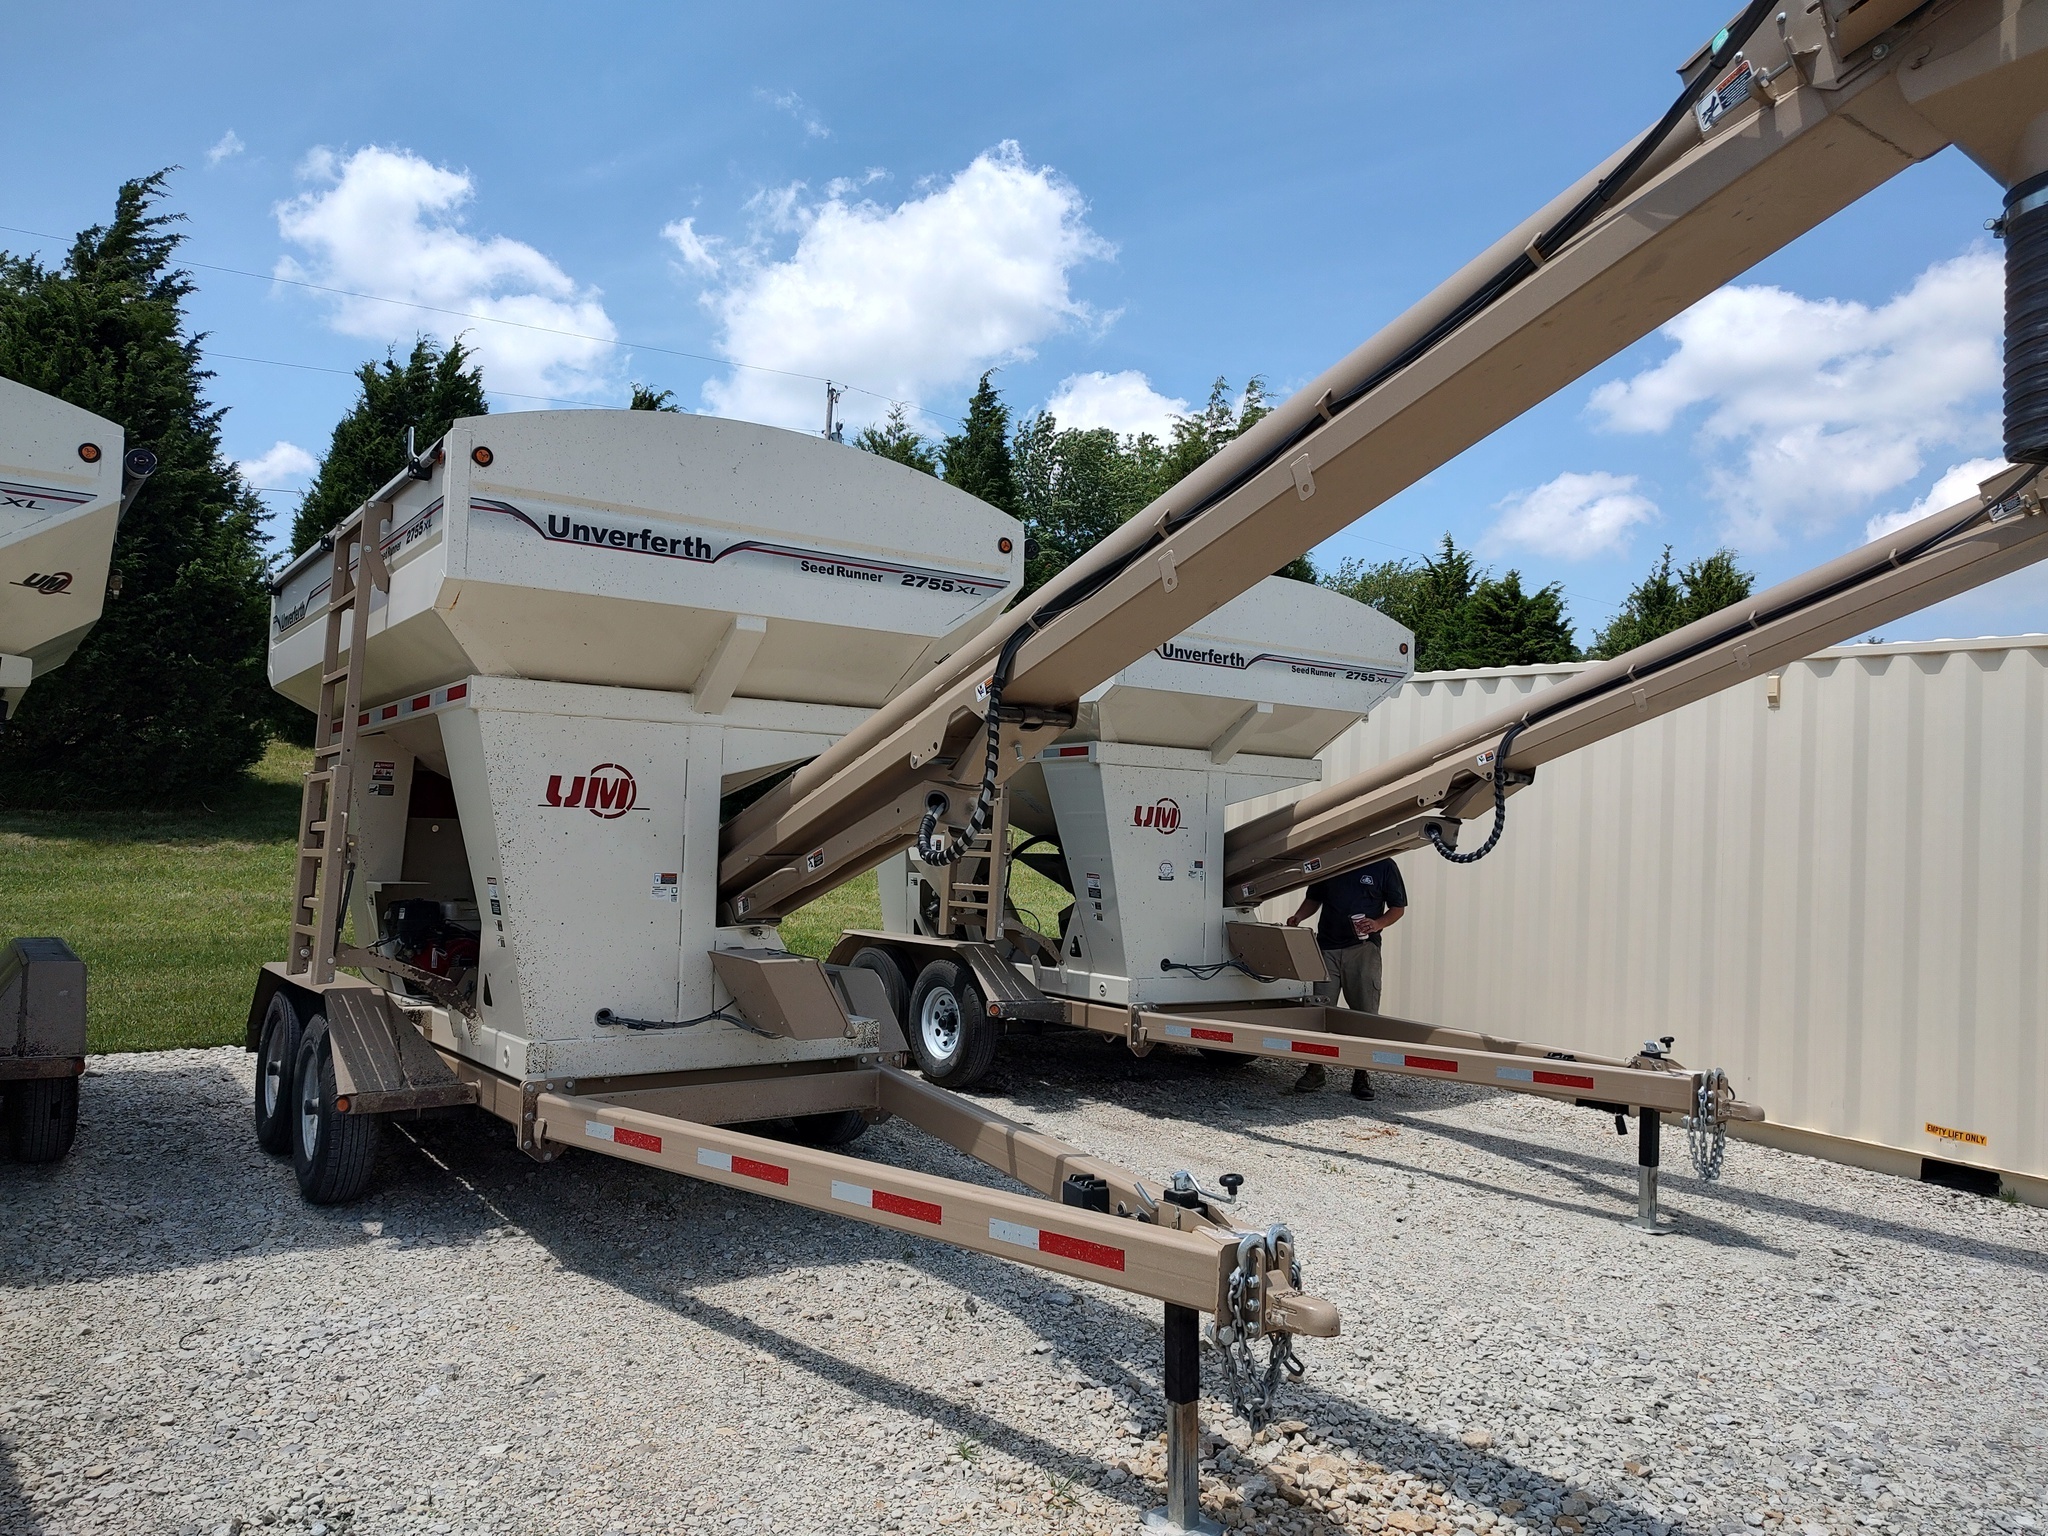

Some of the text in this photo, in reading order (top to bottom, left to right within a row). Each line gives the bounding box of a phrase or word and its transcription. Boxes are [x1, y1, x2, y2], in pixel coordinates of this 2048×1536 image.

[548, 514, 711, 560] Unverferth
[800, 560, 834, 576] Seed
[836, 566, 884, 583] Runner
[1163, 643, 1244, 667] Unverferth
[1291, 665, 1310, 675] Seed
[1310, 667, 1336, 678] Runner
[1927, 1124, 1986, 1145] EMPTY LIFT ONLY
